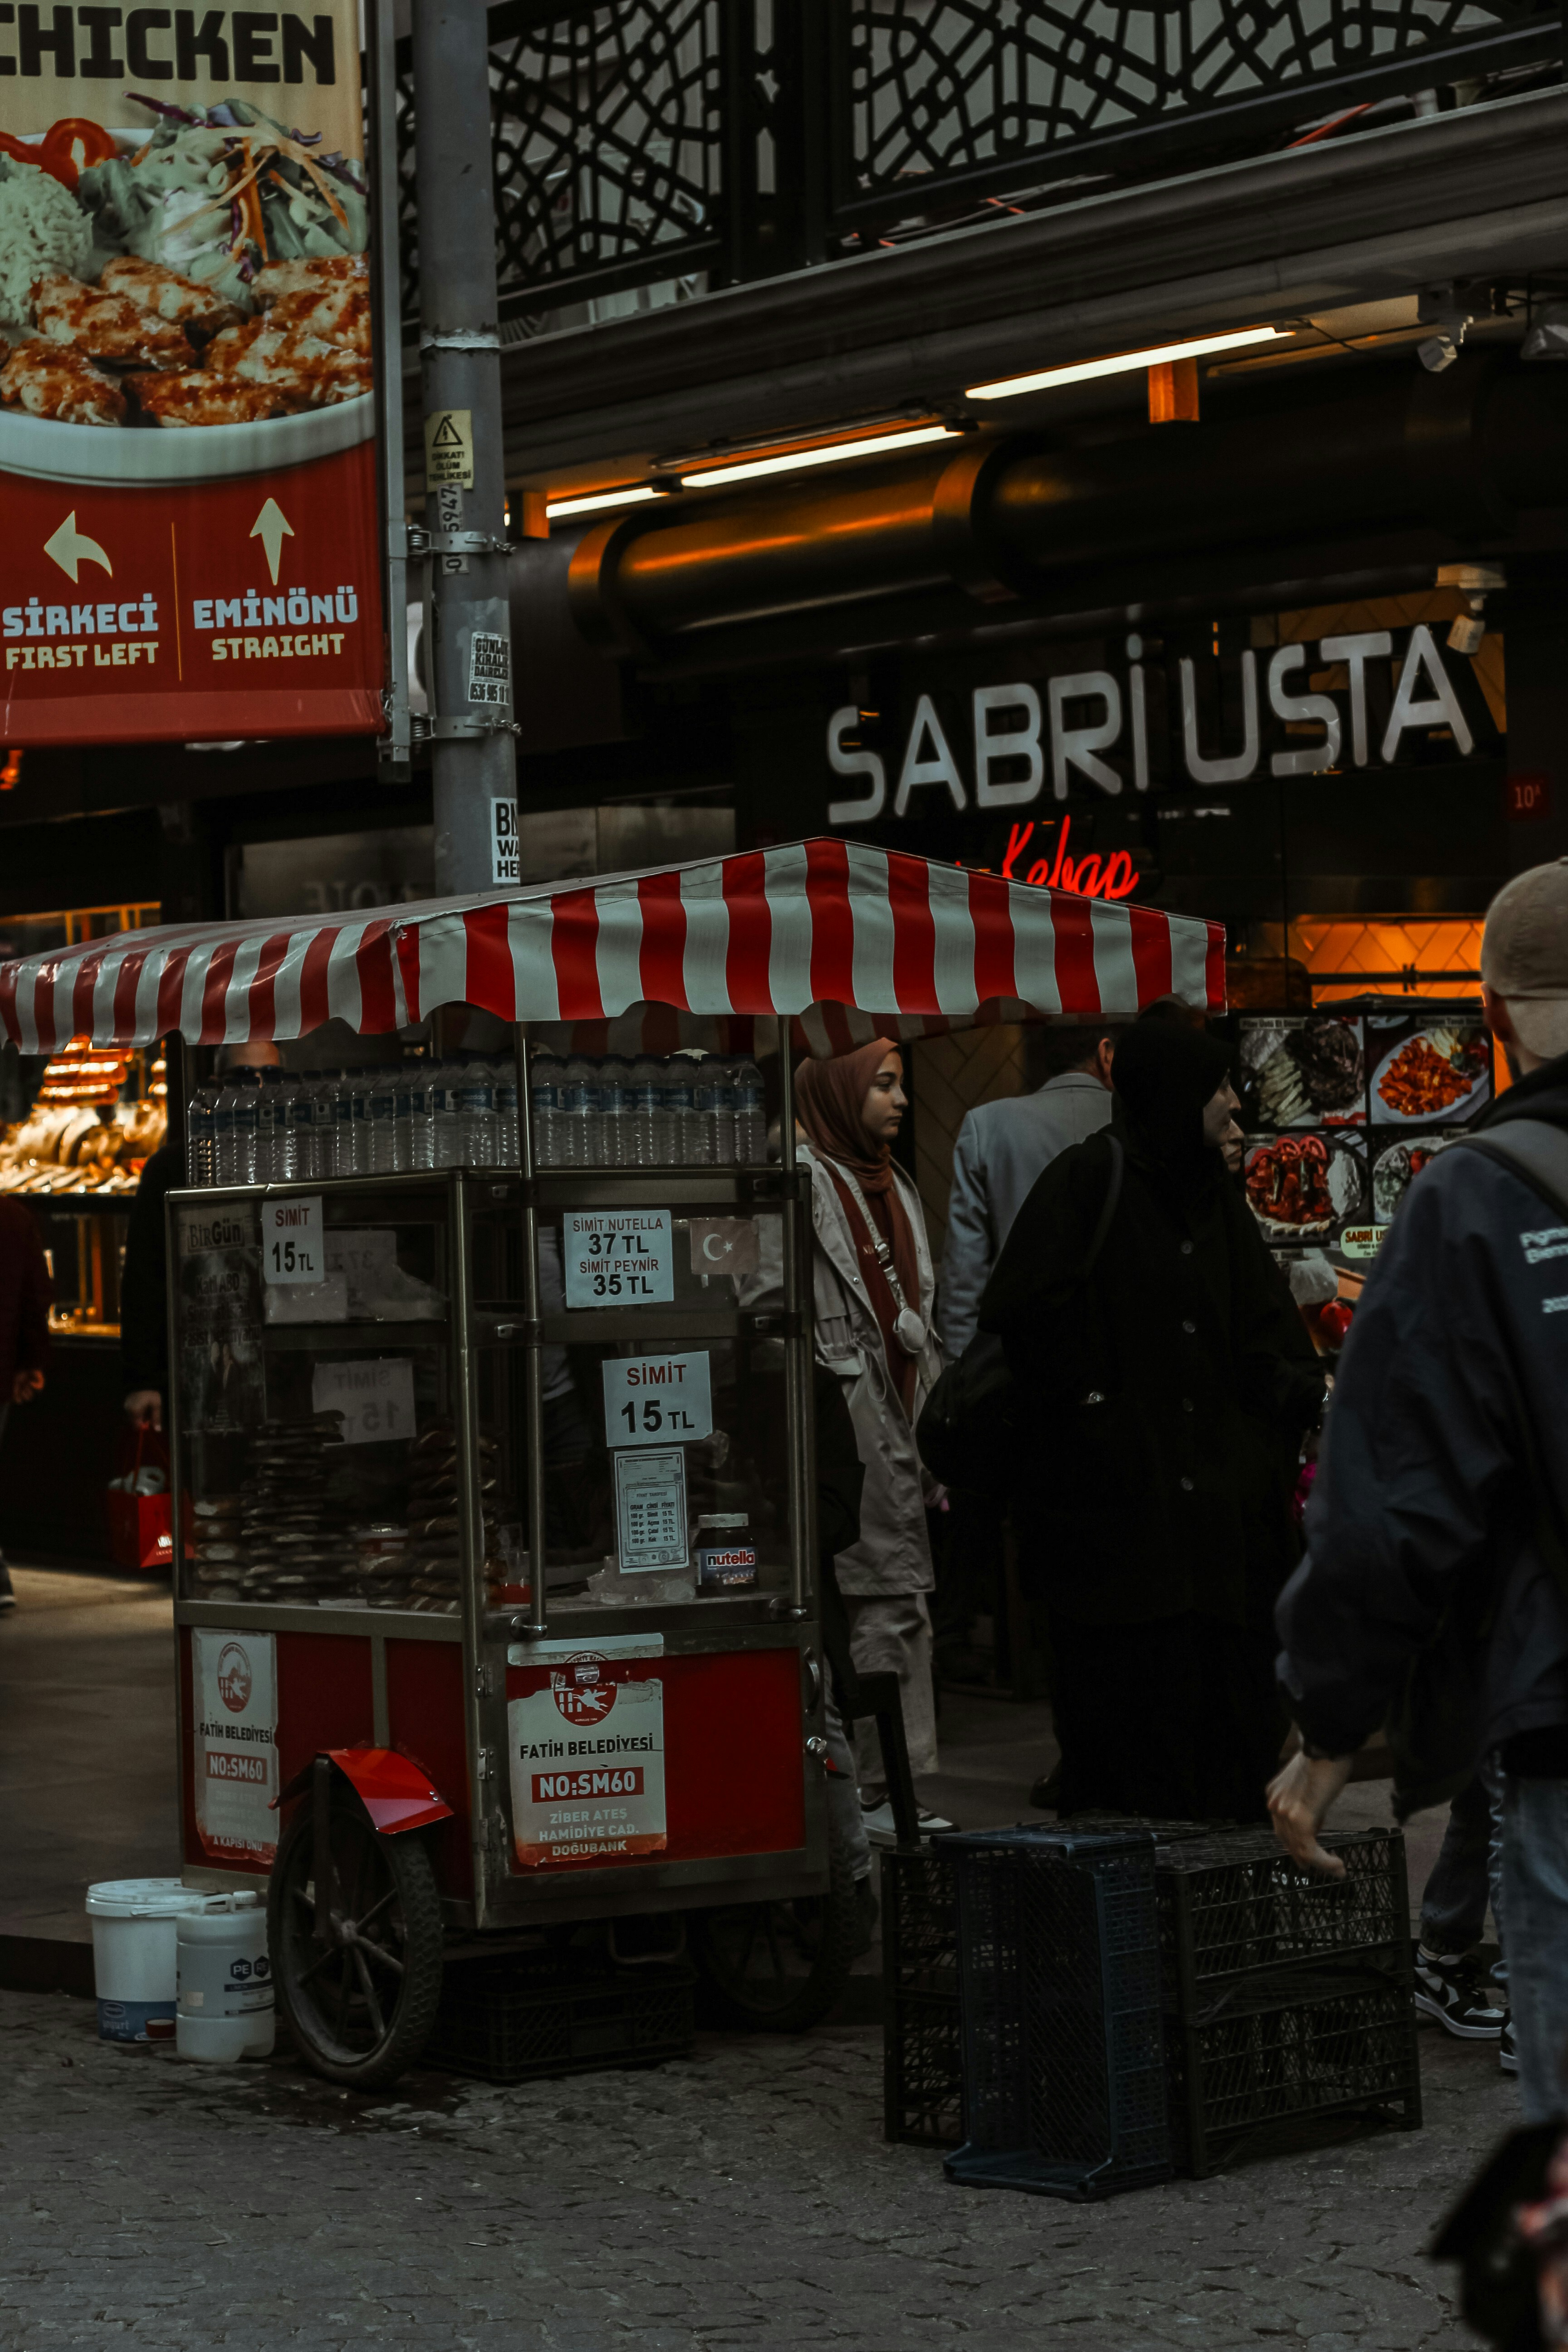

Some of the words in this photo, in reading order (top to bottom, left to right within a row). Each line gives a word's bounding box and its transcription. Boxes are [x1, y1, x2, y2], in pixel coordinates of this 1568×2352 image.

[2, 593, 159, 637] SİRKECİ
[193, 585, 358, 629] EMİNÖNÜ
[6, 645, 88, 670] FIRST
[94, 642, 159, 666] LEFT
[212, 633, 344, 661] STRAIGHT
[827, 633, 1148, 825] SABRİ
[1180, 623, 1475, 786] USTA
[497, 860, 520, 877] HE
[275, 1207, 310, 1227] SİMİT
[573, 1217, 604, 1232] SİMİT
[608, 1217, 663, 1231] NUTELLA
[588, 1233, 616, 1255] 37
[622, 1235, 649, 1254] TL
[1345, 1229, 1373, 1243] SABRİ
[272, 1241, 295, 1272] 15
[299, 1253, 314, 1271] TL
[580, 1258, 610, 1274] SİMİT
[615, 1257, 659, 1272] PEYNİR
[593, 1274, 622, 1296] 35
[627, 1276, 653, 1294] TL
[627, 1362, 686, 1386] SİMİT
[621, 1400, 662, 1433] 15
[667, 1411, 694, 1430] TL
[707, 1549, 755, 1566] nutella
[200, 1720, 223, 1738] FATİH
[225, 1725, 272, 1744] BELEDİYESİ
[520, 1739, 563, 1759] FATİH
[568, 1732, 653, 1755] BELEDİYESİ
[210, 1755, 263, 1780] NO:SM60
[539, 1771, 636, 1798] NO:SM60
[550, 1809, 590, 1825] ZİBER
[593, 1808, 627, 1821] ATEŞ
[539, 1825, 605, 1842] HAMİDİYE
[608, 1823, 639, 1835] CAD.
[552, 1840, 627, 1856] DOĞUBANK
[233, 1964, 250, 1975] PE
